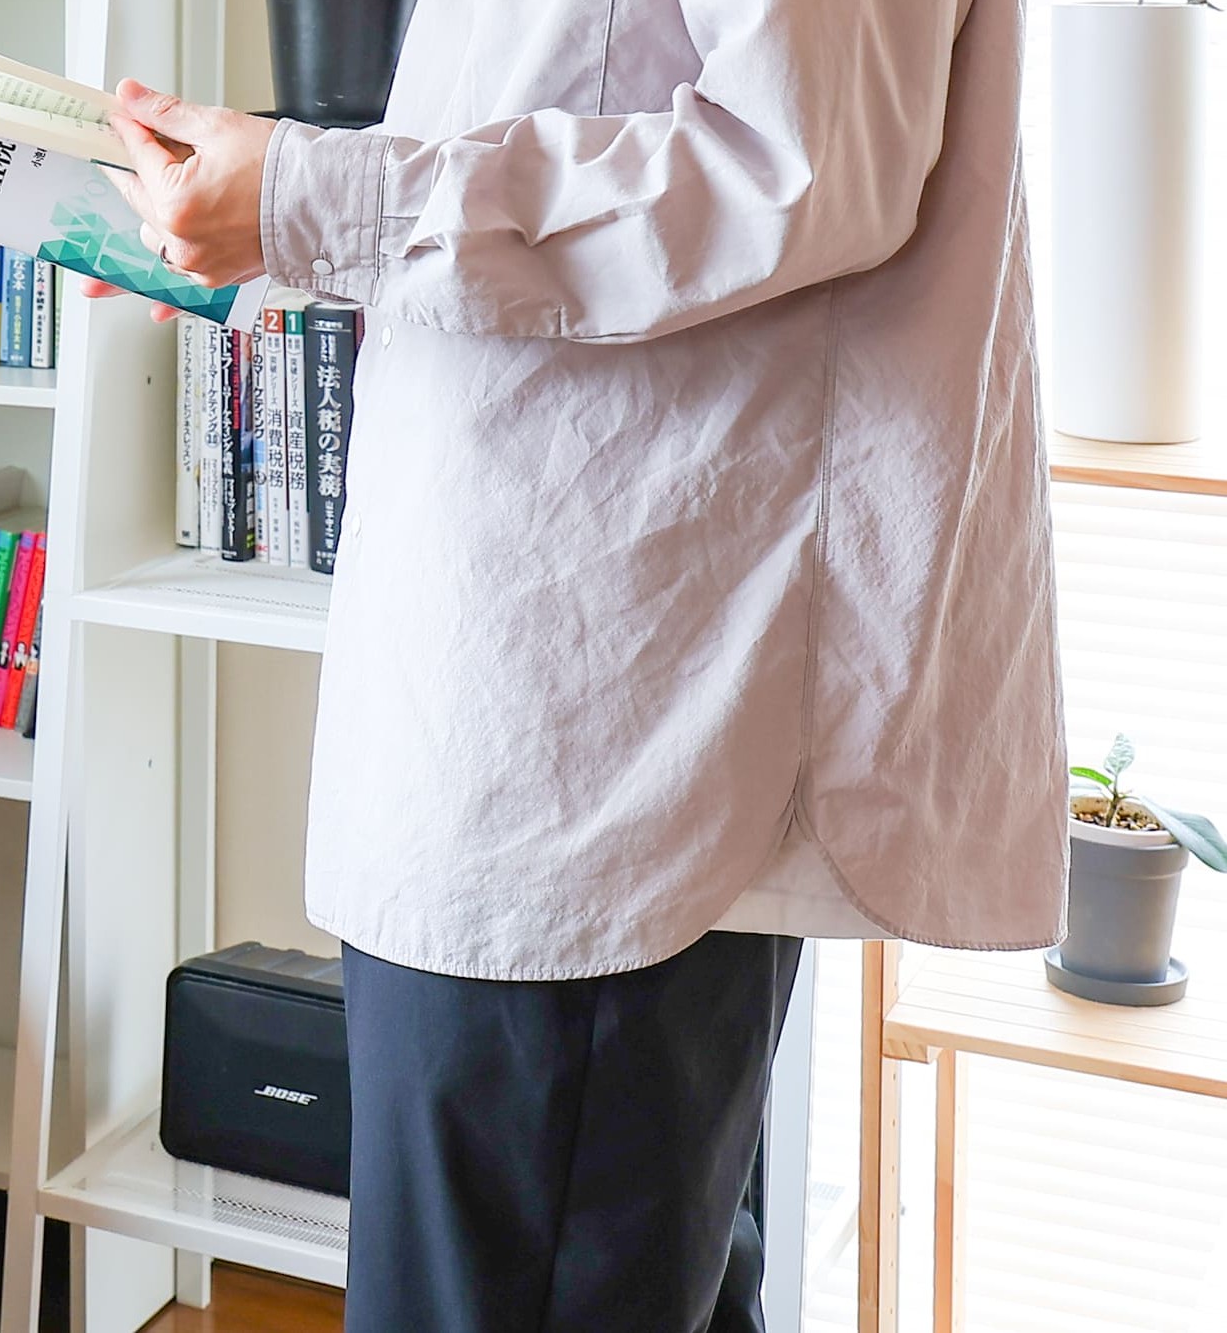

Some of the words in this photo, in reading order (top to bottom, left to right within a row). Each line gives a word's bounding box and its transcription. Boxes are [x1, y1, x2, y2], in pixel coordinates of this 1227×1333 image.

[266, 311, 279, 331] 2
[288, 313, 296, 332] 1
[267, 409, 285, 489] 消費税務
[288, 411, 306, 491] 資産税務
[316, 364, 343, 498] 法人税の実務
[254, 1084, 318, 1105] BOSE
